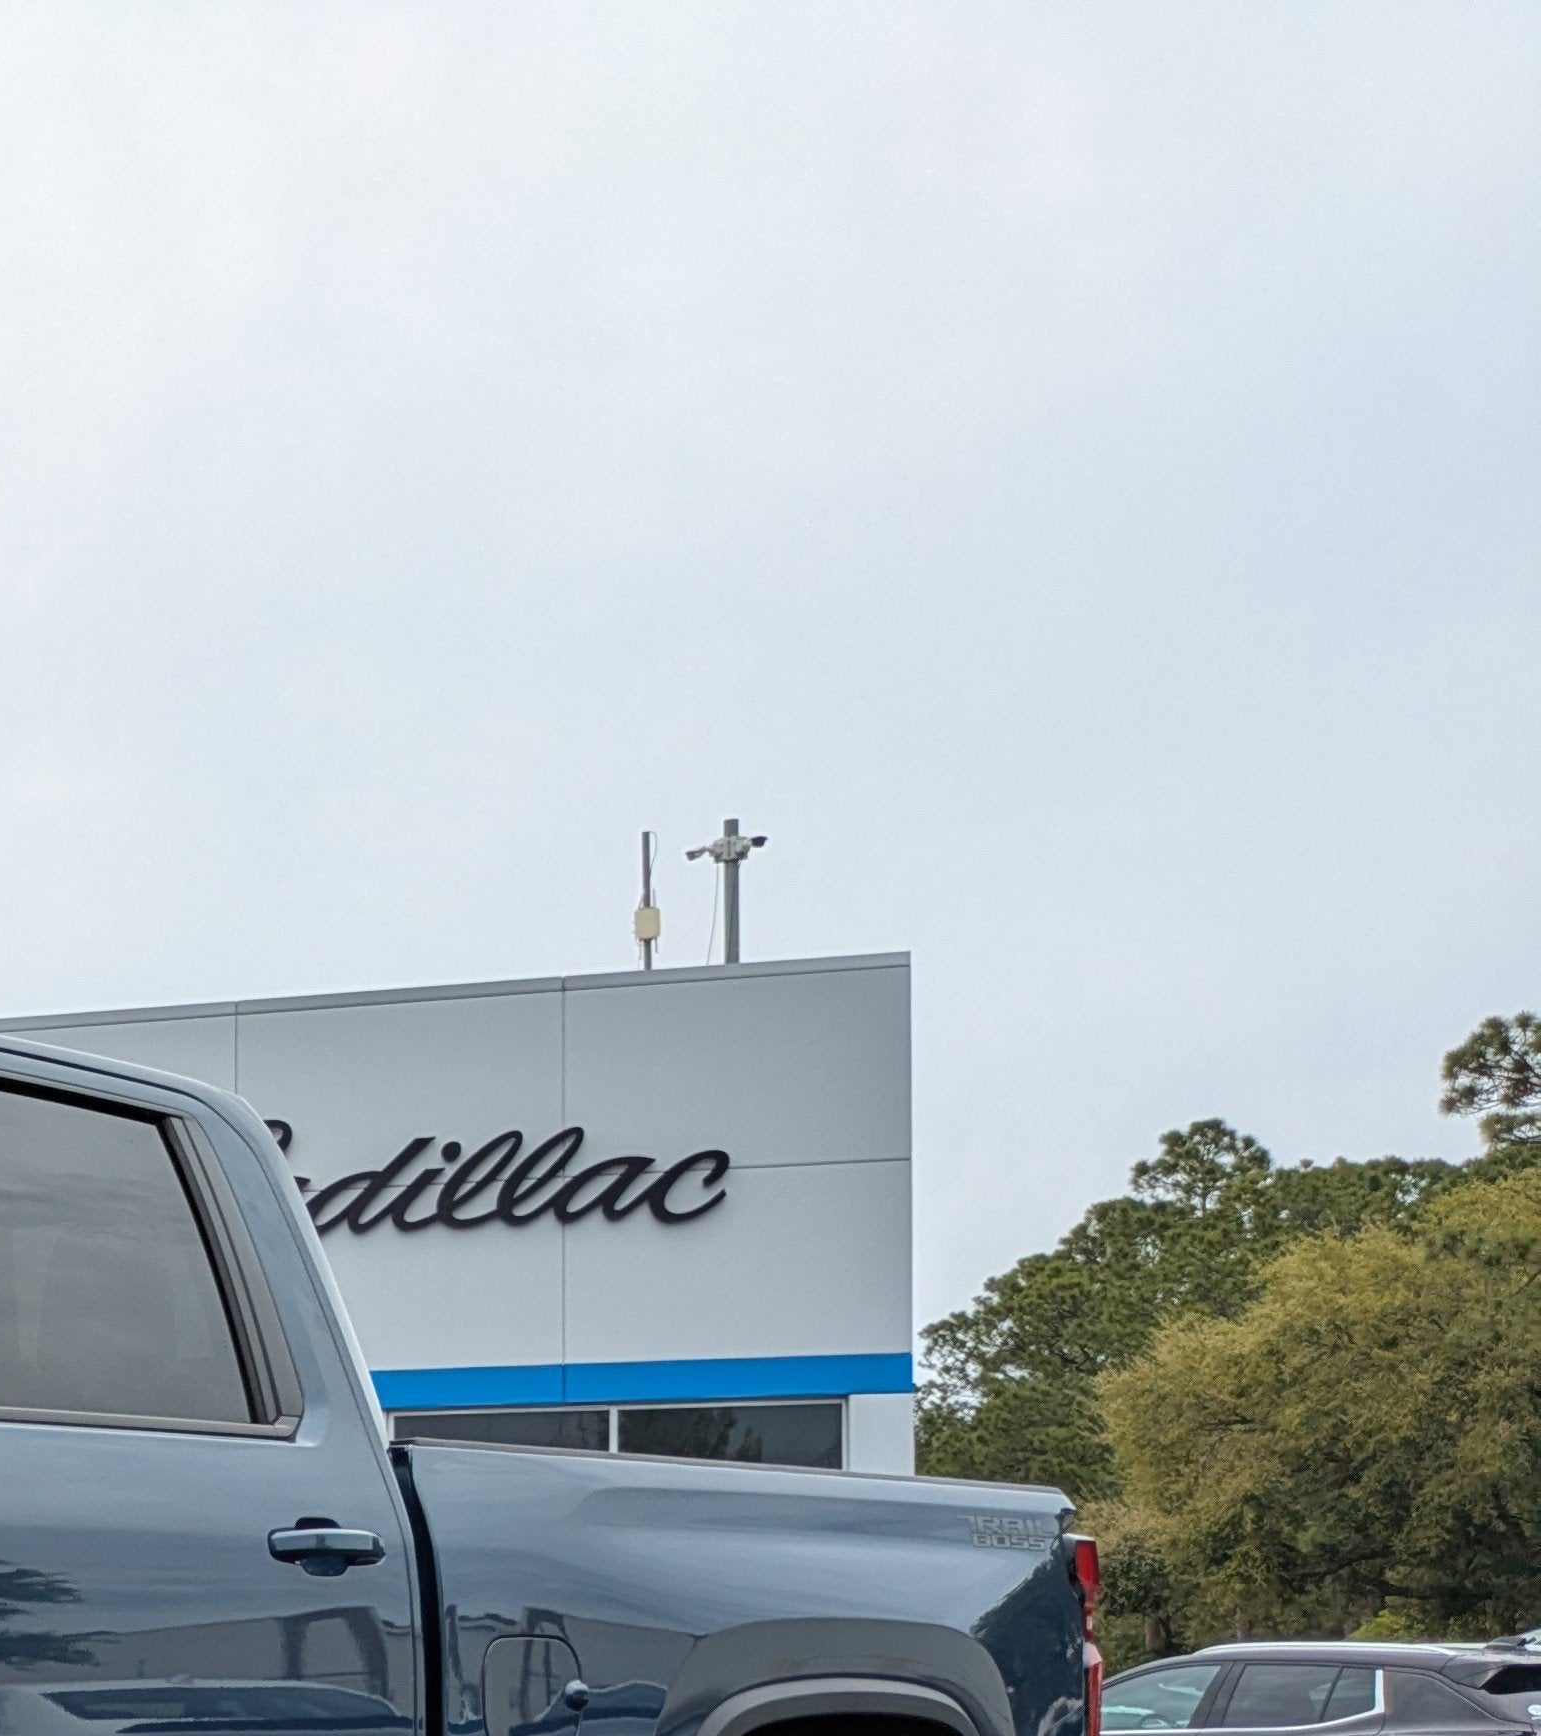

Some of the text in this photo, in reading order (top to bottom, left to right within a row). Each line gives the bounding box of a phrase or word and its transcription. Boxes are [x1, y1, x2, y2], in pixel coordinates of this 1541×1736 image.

[263, 1119, 730, 1235] dillac
[956, 1514, 1057, 1536] TRAIL
[971, 1533, 1048, 1551] BOSS
